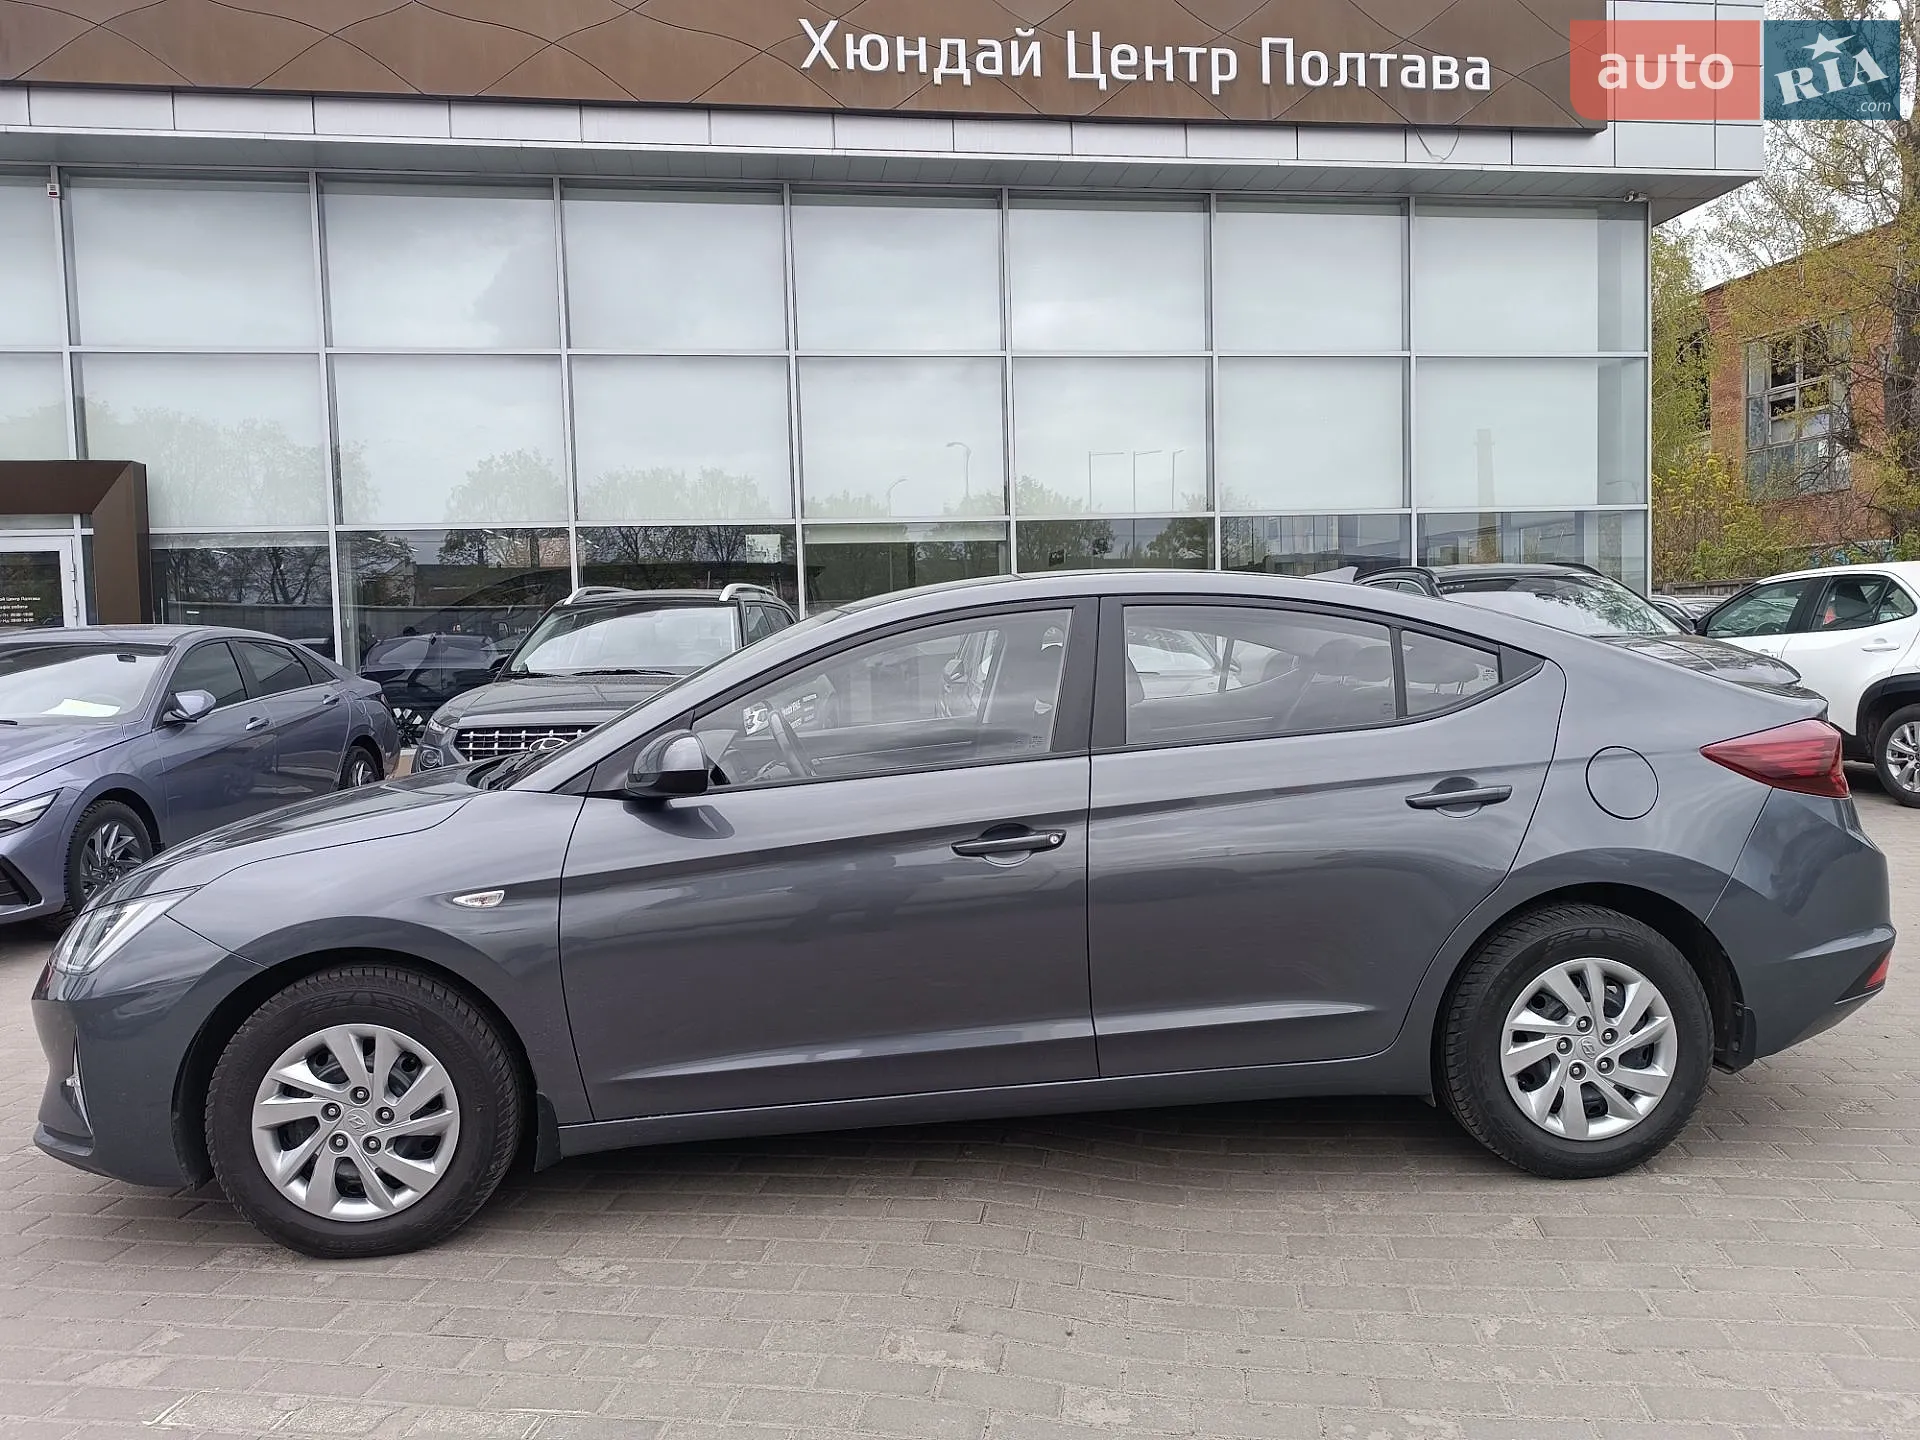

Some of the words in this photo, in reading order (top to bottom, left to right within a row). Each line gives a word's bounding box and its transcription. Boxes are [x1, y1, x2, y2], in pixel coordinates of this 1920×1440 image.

[798, 18, 1042, 91] Хюндай
[1067, 30, 1238, 95] Центр
[1261, 37, 1490, 92] Полтава
